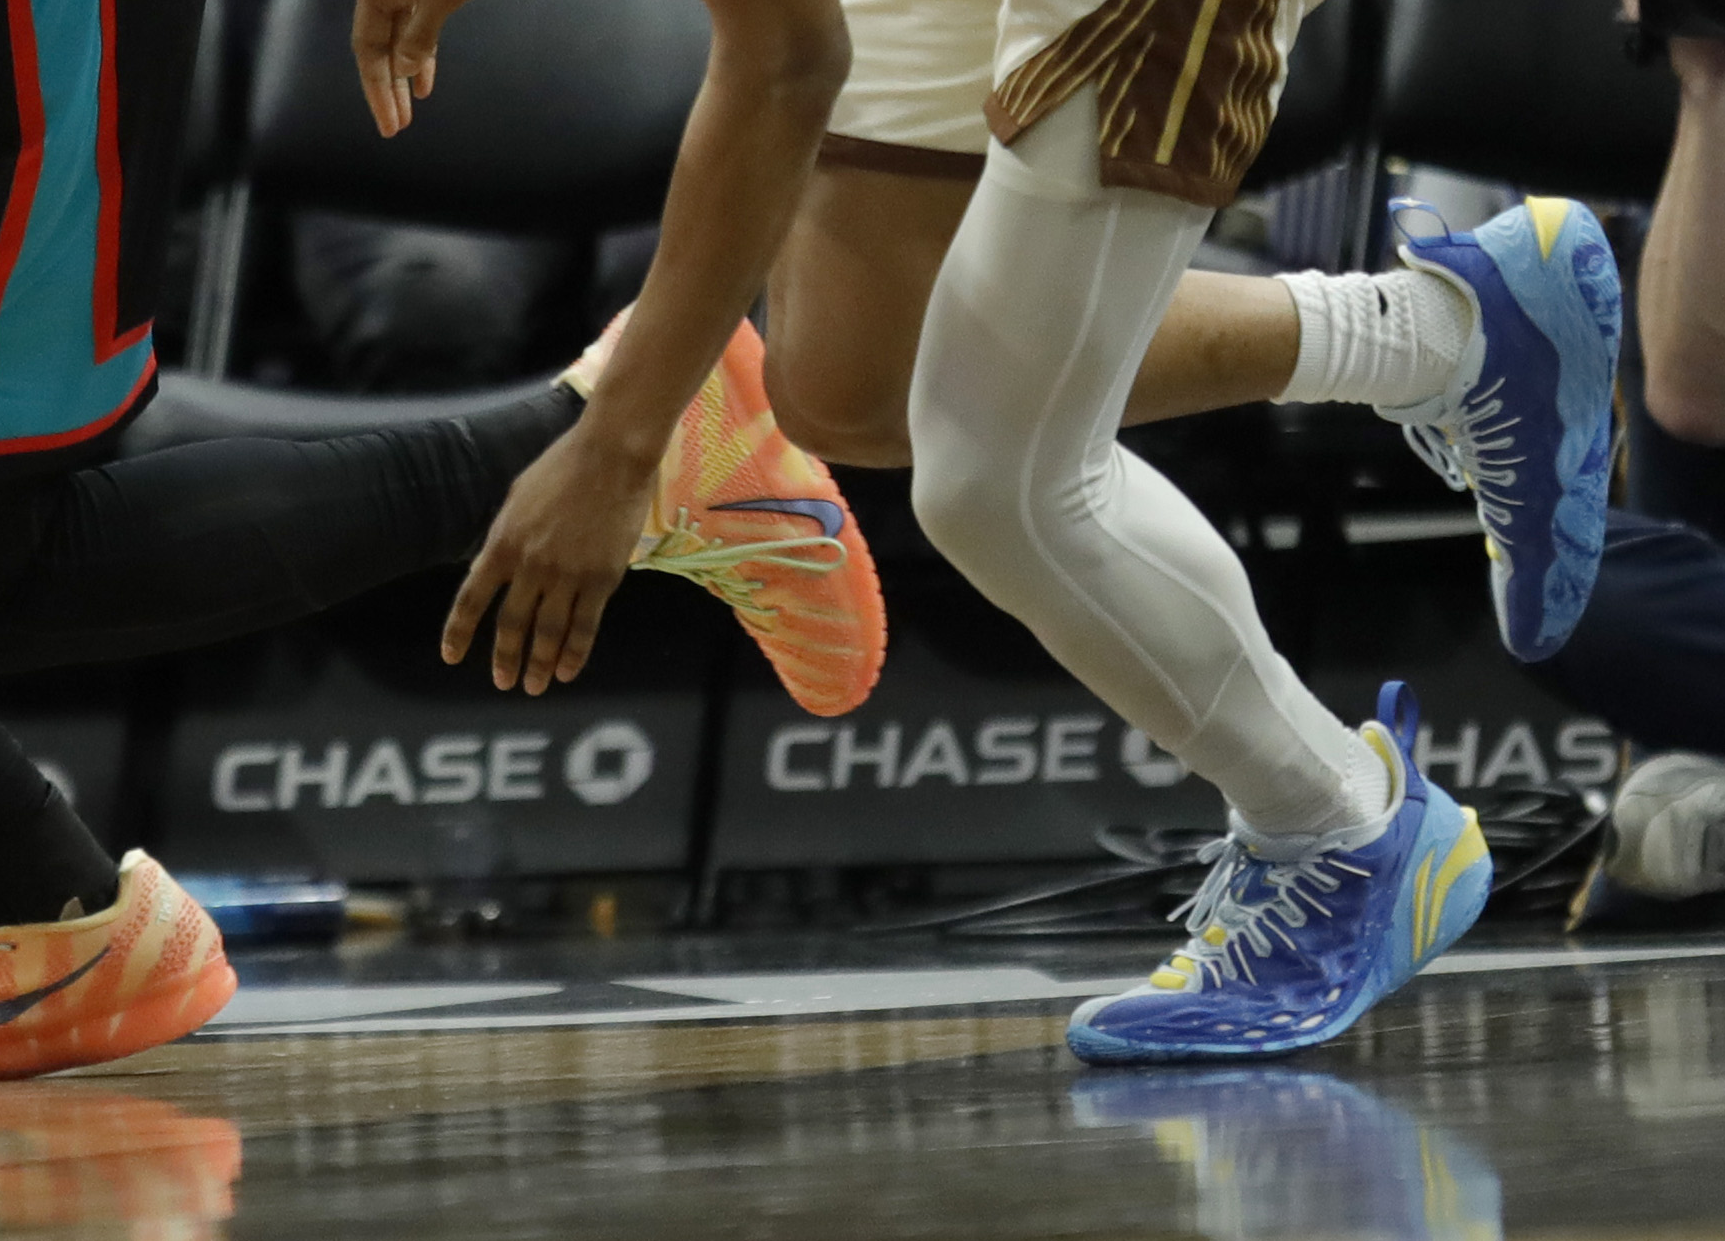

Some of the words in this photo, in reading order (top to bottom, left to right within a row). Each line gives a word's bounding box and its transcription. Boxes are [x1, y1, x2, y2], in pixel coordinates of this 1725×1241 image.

[212, 731, 551, 812] CHASE
[765, 714, 1106, 791] CHASE
[1409, 716, 1618, 788] HAS
